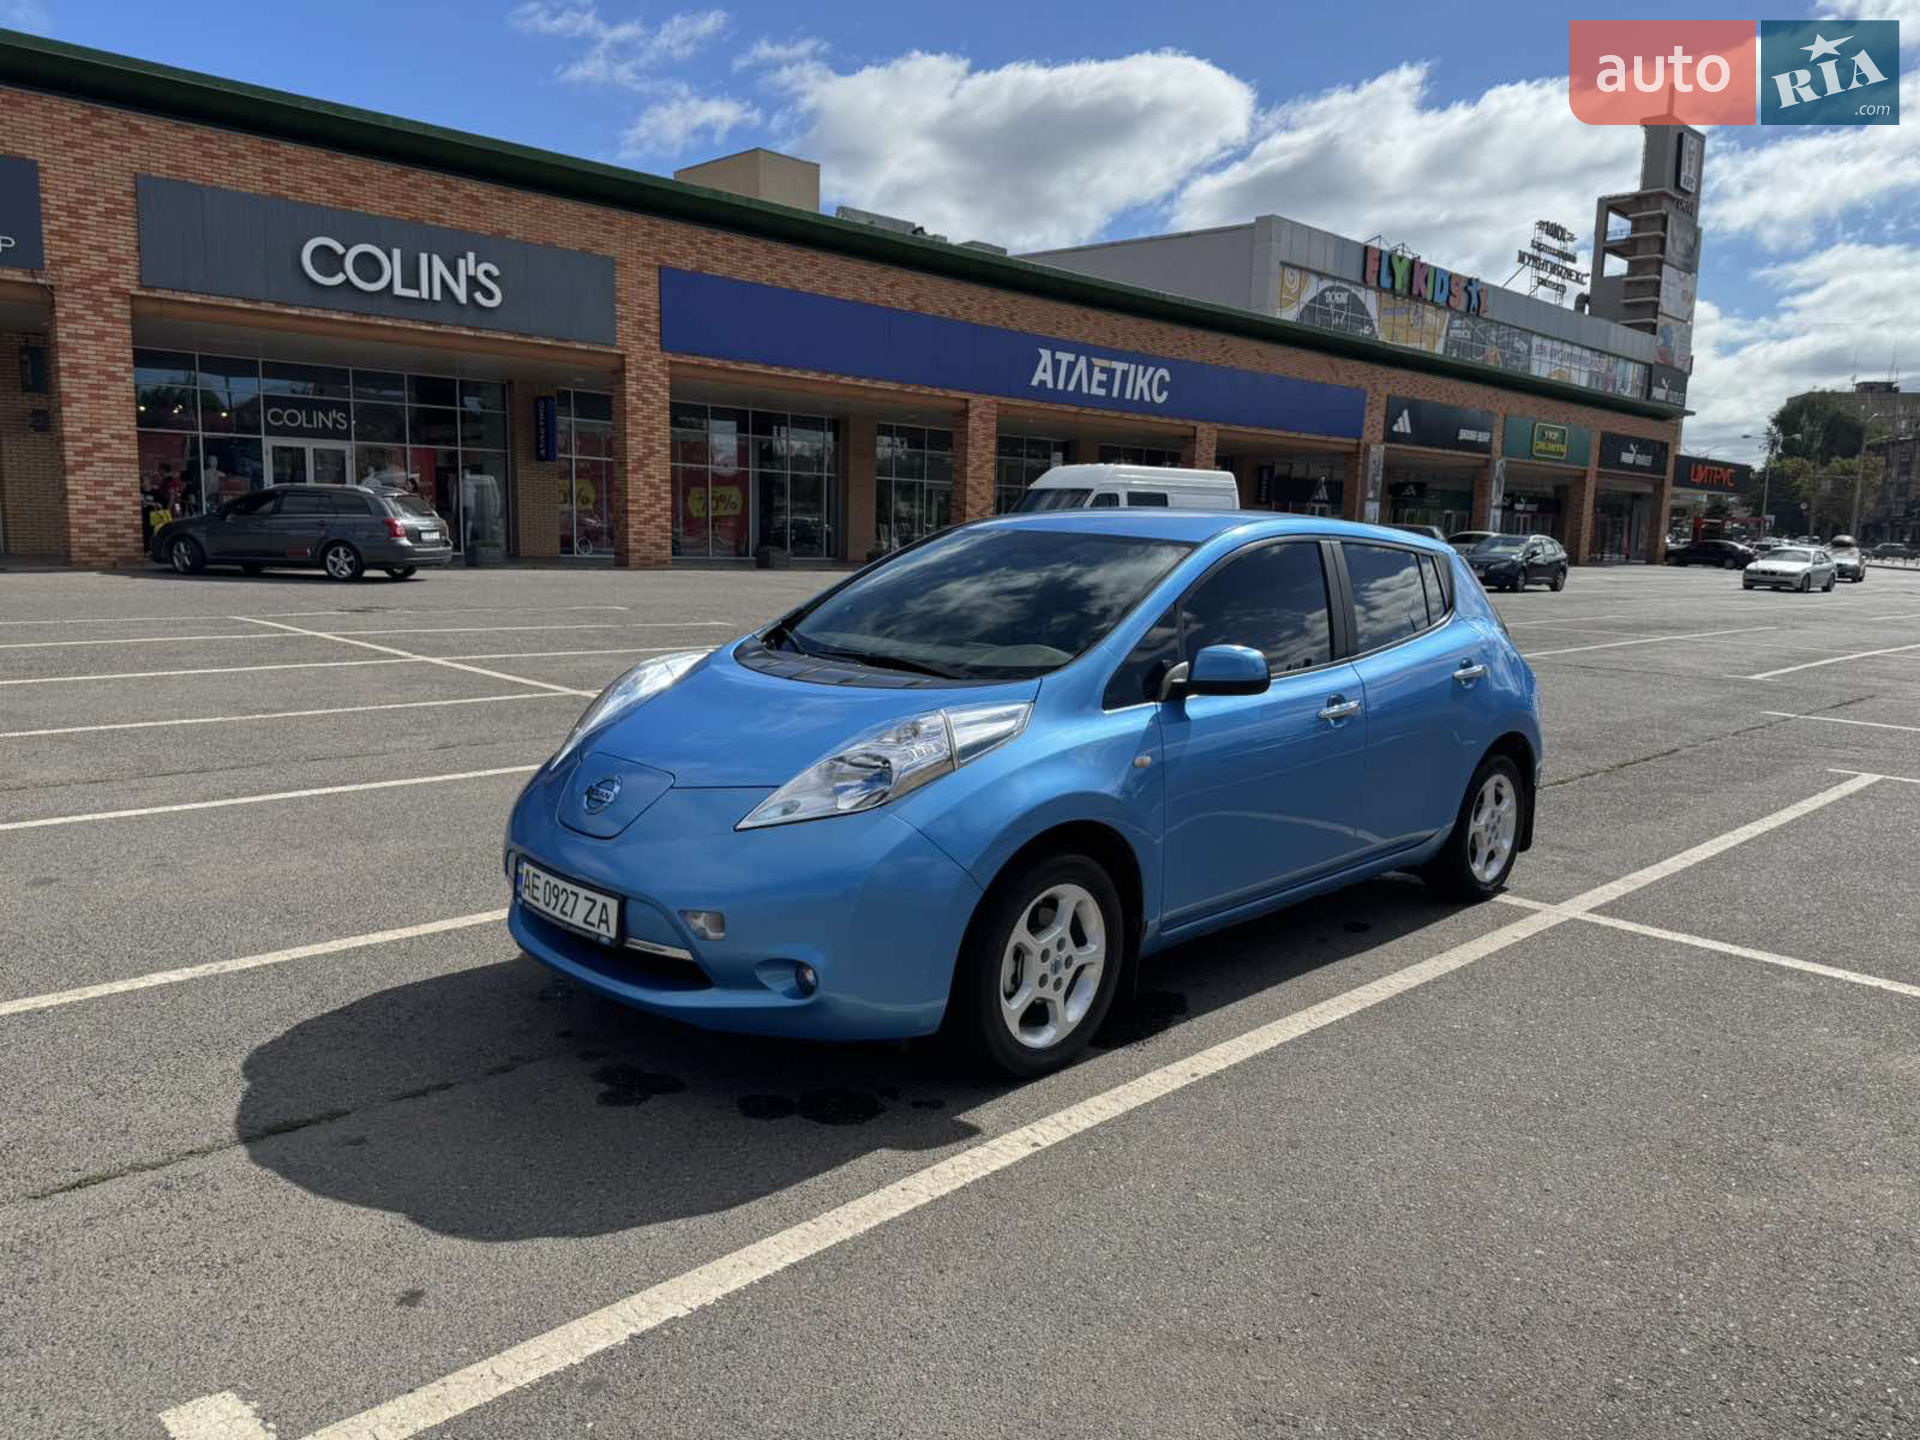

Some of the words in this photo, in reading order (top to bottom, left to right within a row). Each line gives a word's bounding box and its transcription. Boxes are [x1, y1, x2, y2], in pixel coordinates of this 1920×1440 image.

[301, 236, 502, 308] COLIN'S
[267, 408, 347, 430] COLIN'S
[523, 869, 541, 903] AE
[543, 880, 579, 919] 0927
[583, 896, 611, 934] ZA
